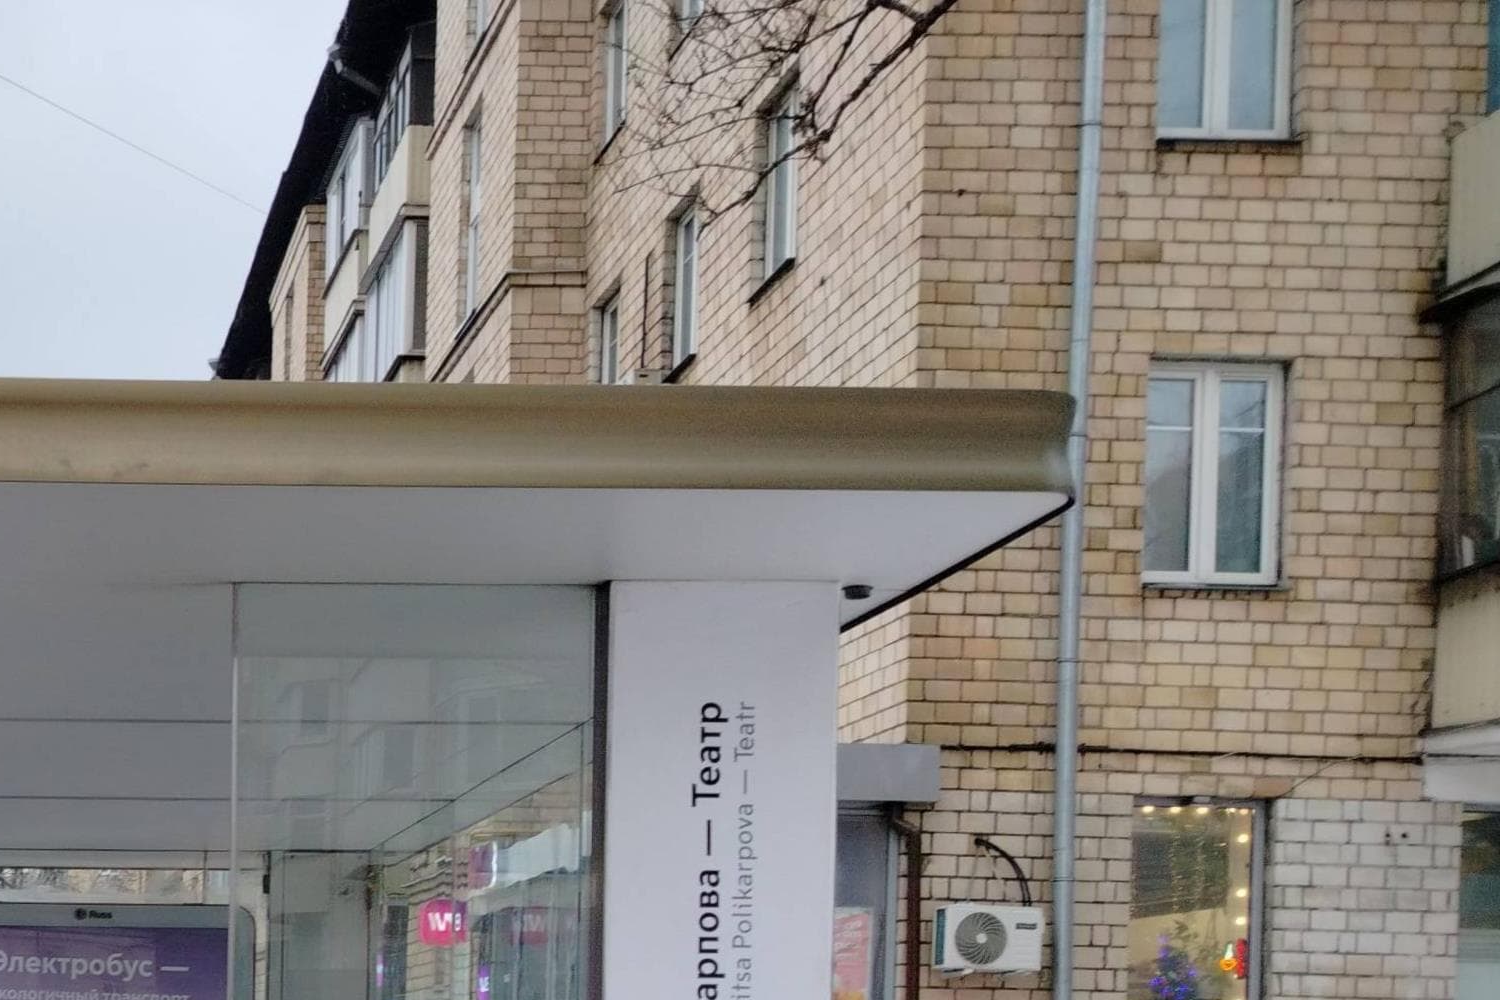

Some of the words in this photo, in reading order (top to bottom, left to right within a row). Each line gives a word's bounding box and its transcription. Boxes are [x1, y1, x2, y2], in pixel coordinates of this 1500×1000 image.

[691, 701, 729, 808] Театр
[733, 700, 756, 763] Teatr
[731, 802, 758, 950] Polikarpova
